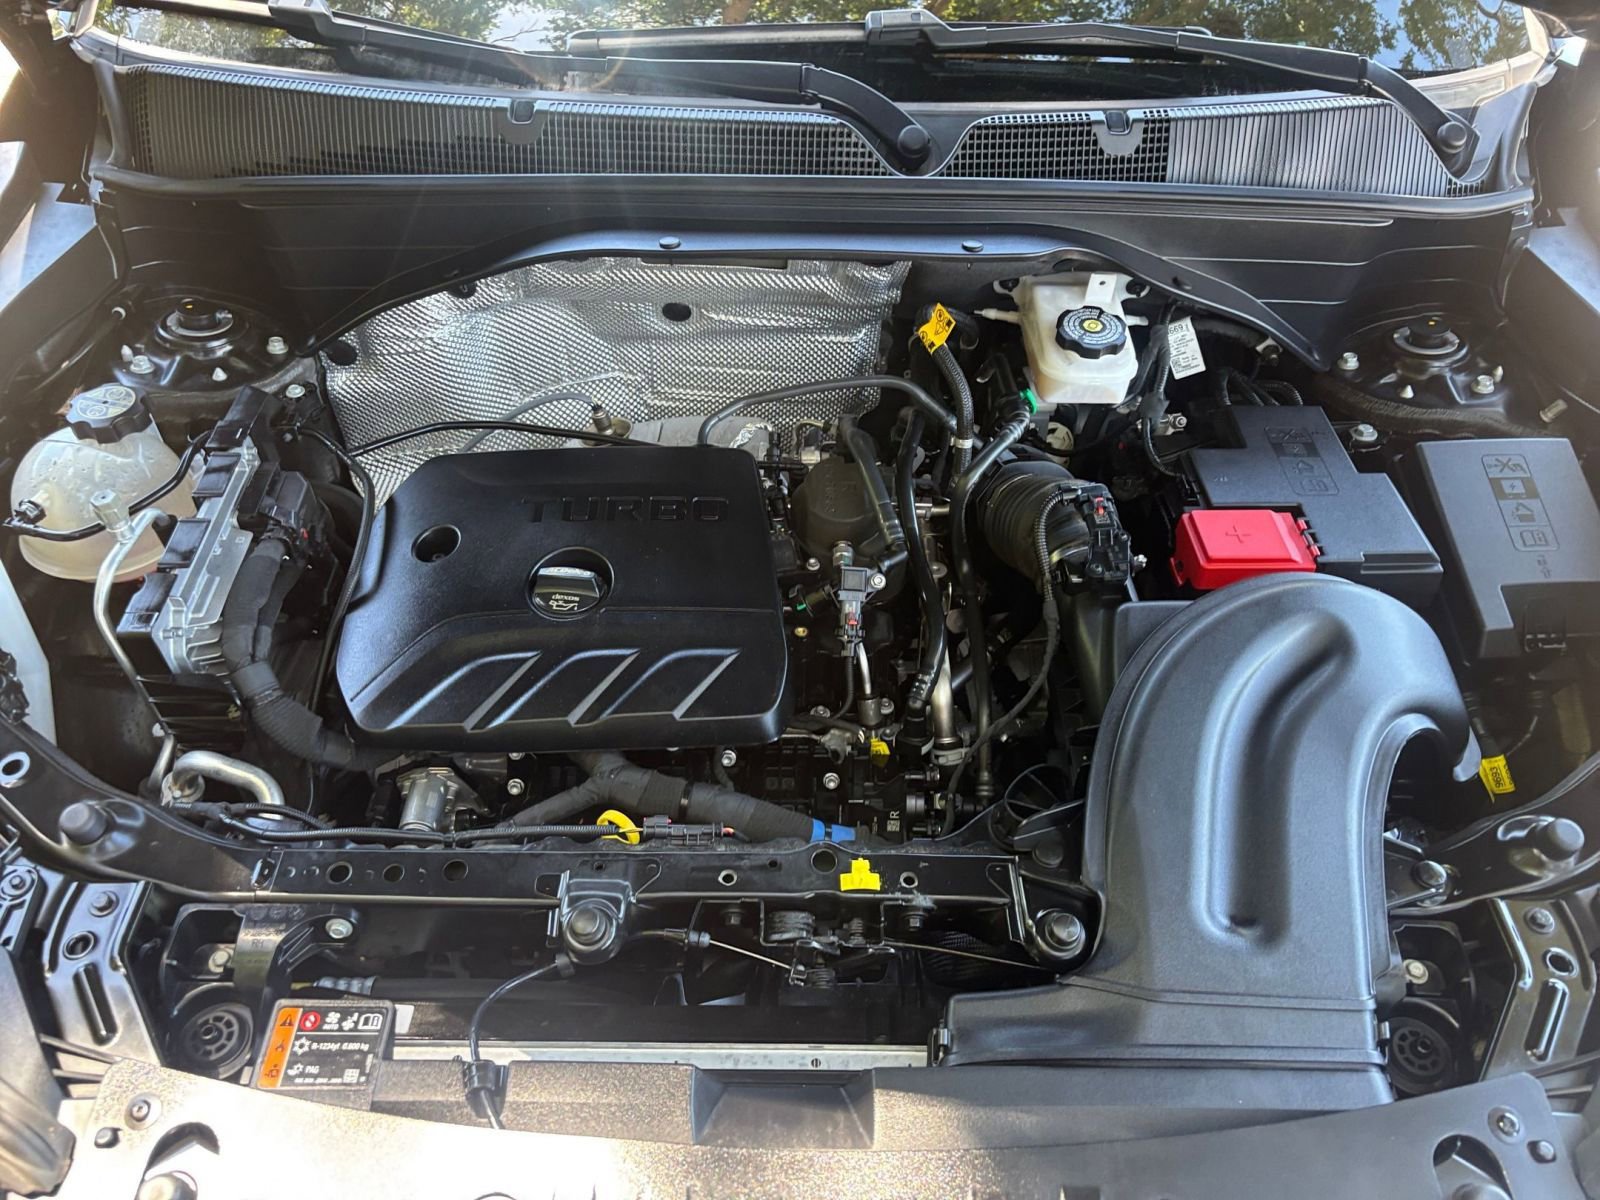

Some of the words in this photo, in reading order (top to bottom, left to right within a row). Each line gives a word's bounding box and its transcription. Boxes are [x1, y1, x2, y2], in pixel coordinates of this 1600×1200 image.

[521, 497, 729, 522] TURBO
[552, 593, 580, 602] dexos
[322, 1023, 340, 1031] AUTO
[304, 1065, 320, 1075] PAG
